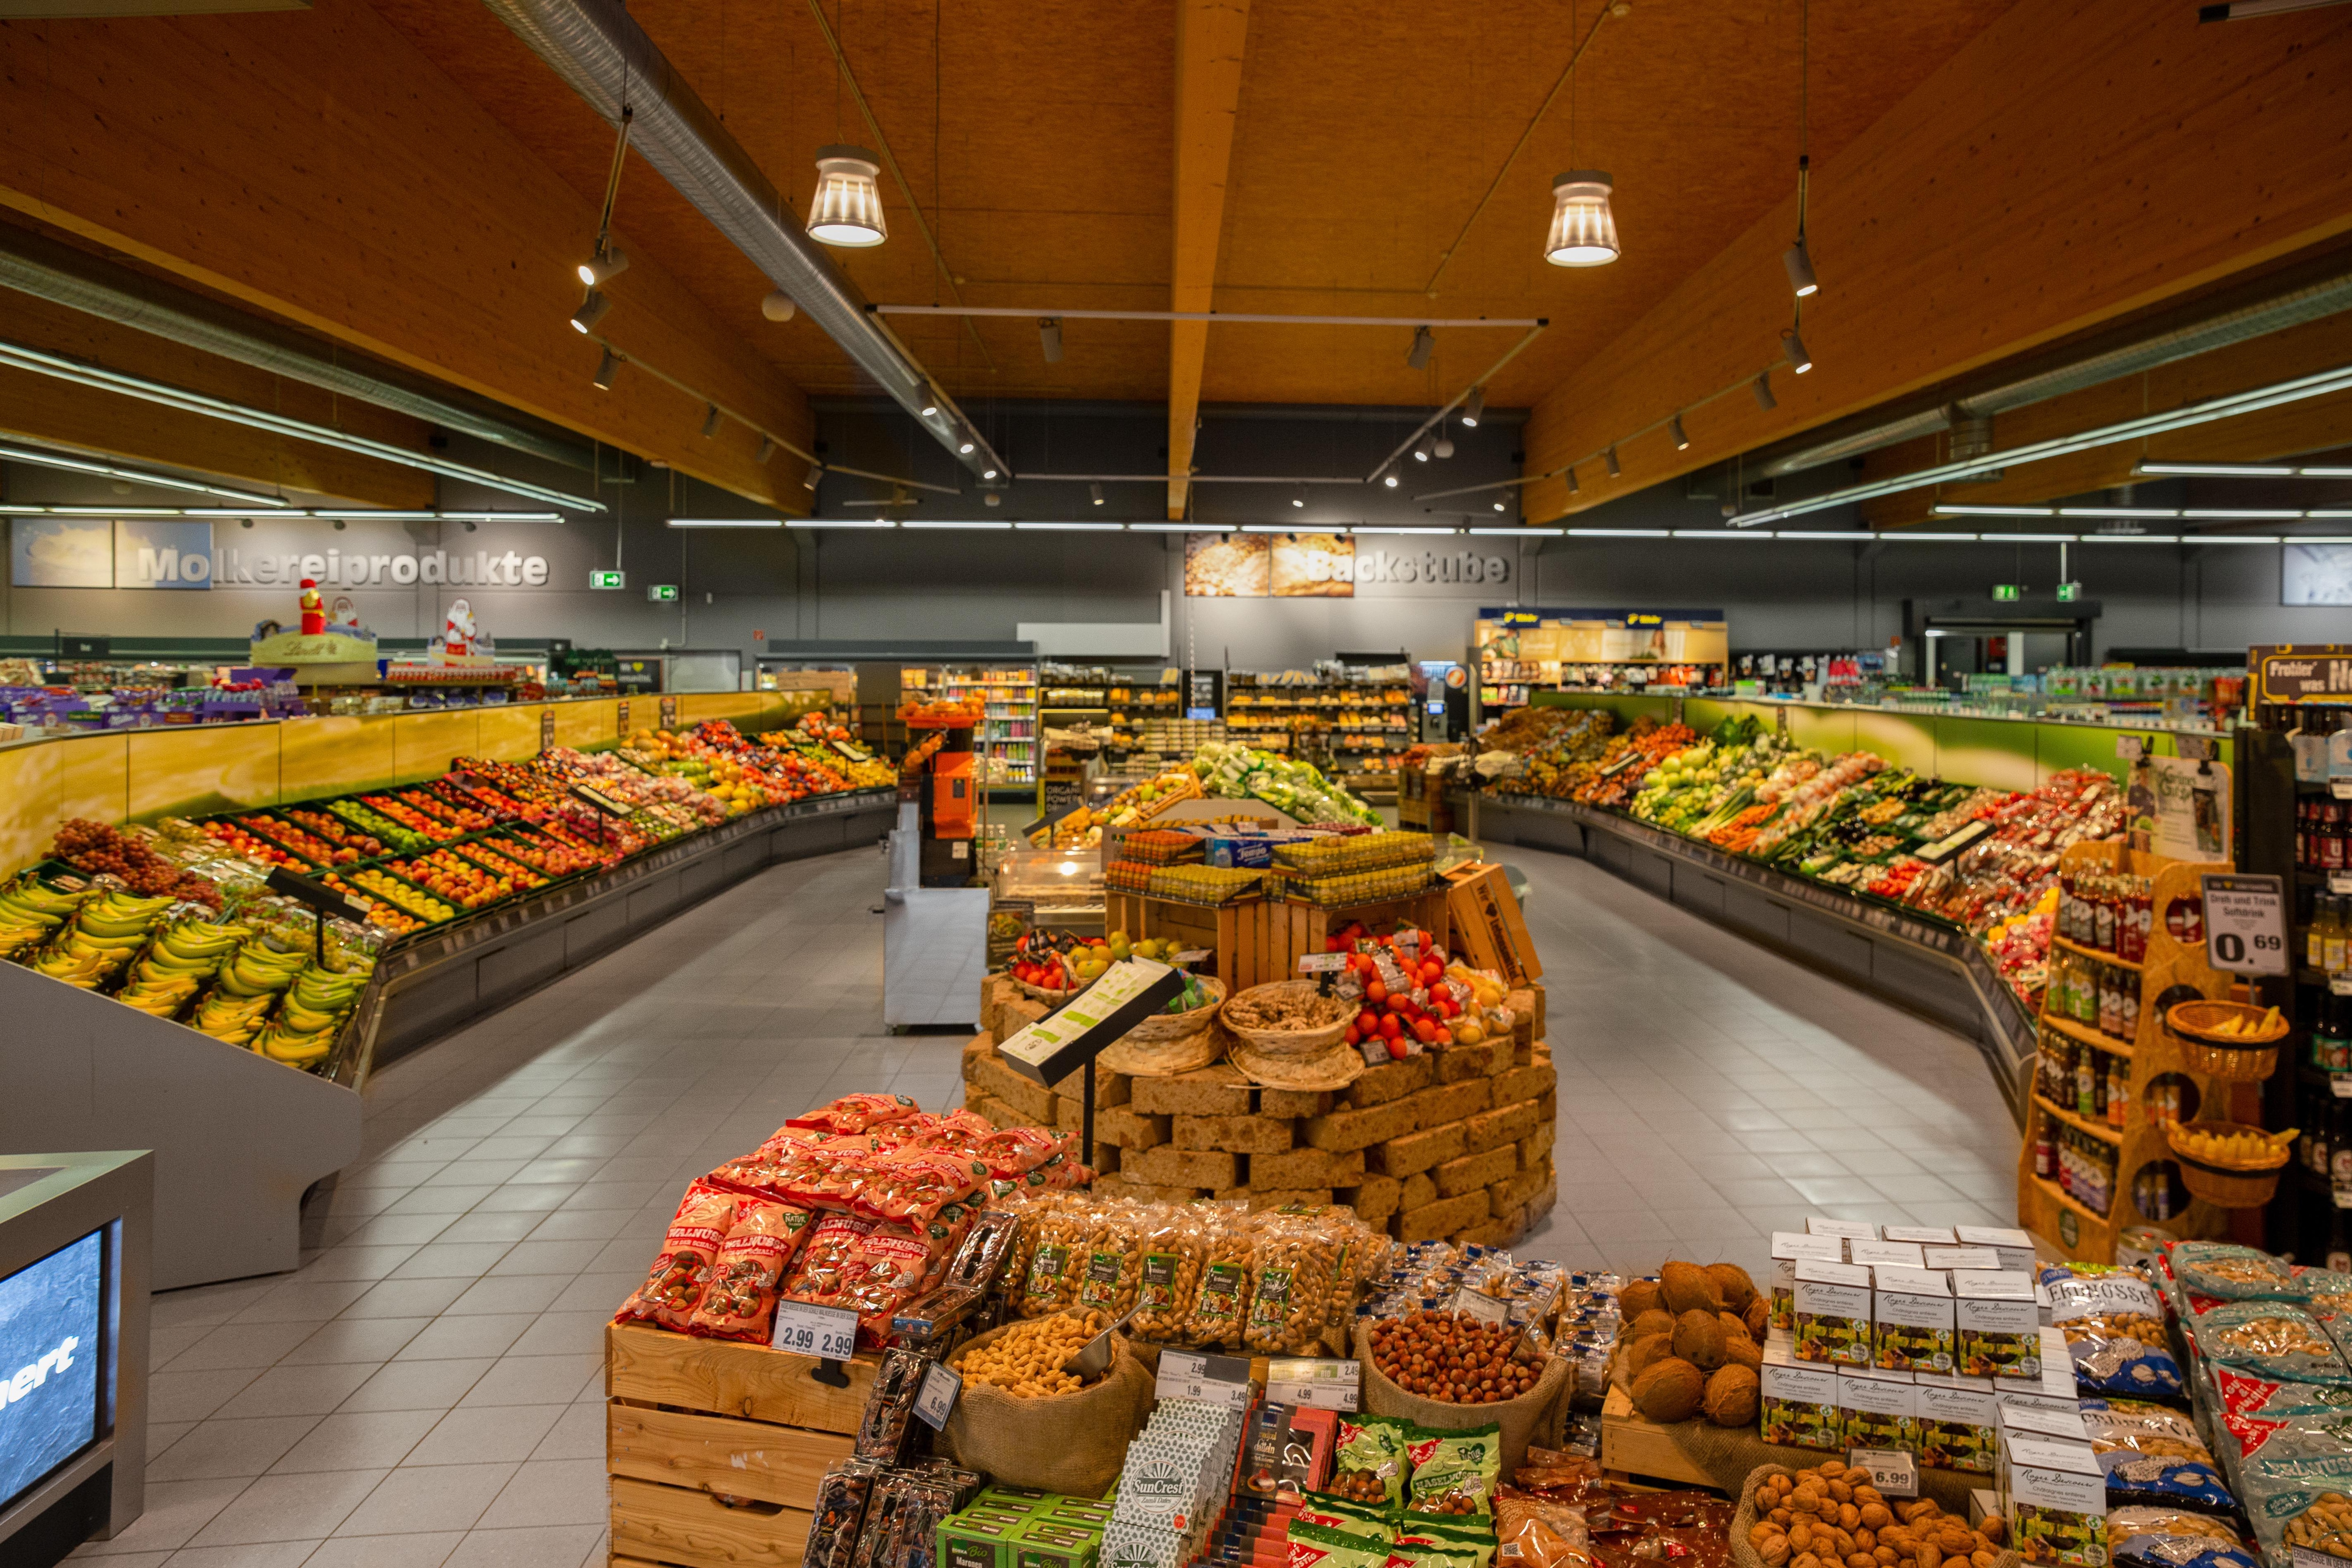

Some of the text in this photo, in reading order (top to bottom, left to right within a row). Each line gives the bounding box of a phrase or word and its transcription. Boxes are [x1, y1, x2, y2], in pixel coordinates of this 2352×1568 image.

[138, 548, 548, 591] Molkereiprodukte
[1307, 550, 1508, 583] Backstube
[2329, 660, 2352, 692] N
[2299, 680, 2326, 692] was
[1238, 843, 1267, 861] Tempo
[2216, 934, 2280, 964] 0.69
[785, 1214, 806, 1223] NATUR
[691, 1240, 717, 1251] SCHALE
[862, 1237, 930, 1256] WALNÜSSE
[1802, 1283, 1824, 1296] Roger
[1883, 1294, 1906, 1307] Roger
[1965, 1302, 1987, 1314] Roger
[783, 1327, 814, 1348] 2.99
[822, 1334, 852, 1355] 2.99
[1192, 1363, 1205, 1374] 2.99
[1345, 1365, 1359, 1376] 2.49
[1769, 1368, 1790, 1381] Roger
[1187, 1385, 1200, 1396] 1.99
[1844, 1379, 1867, 1393] Roger
[1231, 1390, 1245, 1402] 3.49
[1297, 1389, 1311, 1400] 4.99
[1343, 1393, 1358, 1404] 4.99
[1923, 1389, 1946, 1402] Roger
[2004, 1394, 2027, 1406] Roger
[930, 1397, 947, 1416] 6.99
[1461, 1448, 1484, 1461] NATUR
[1875, 1471, 1909, 1484] 6.99
[2022, 1469, 2048, 1485] Roger
[1133, 1479, 1184, 1494] SunCrest
[968, 1546, 988, 1557] Bio
[956, 1556, 982, 1568] Maronen
[2294, 1549, 2344, 1568] ERDNUESSE IN DER
